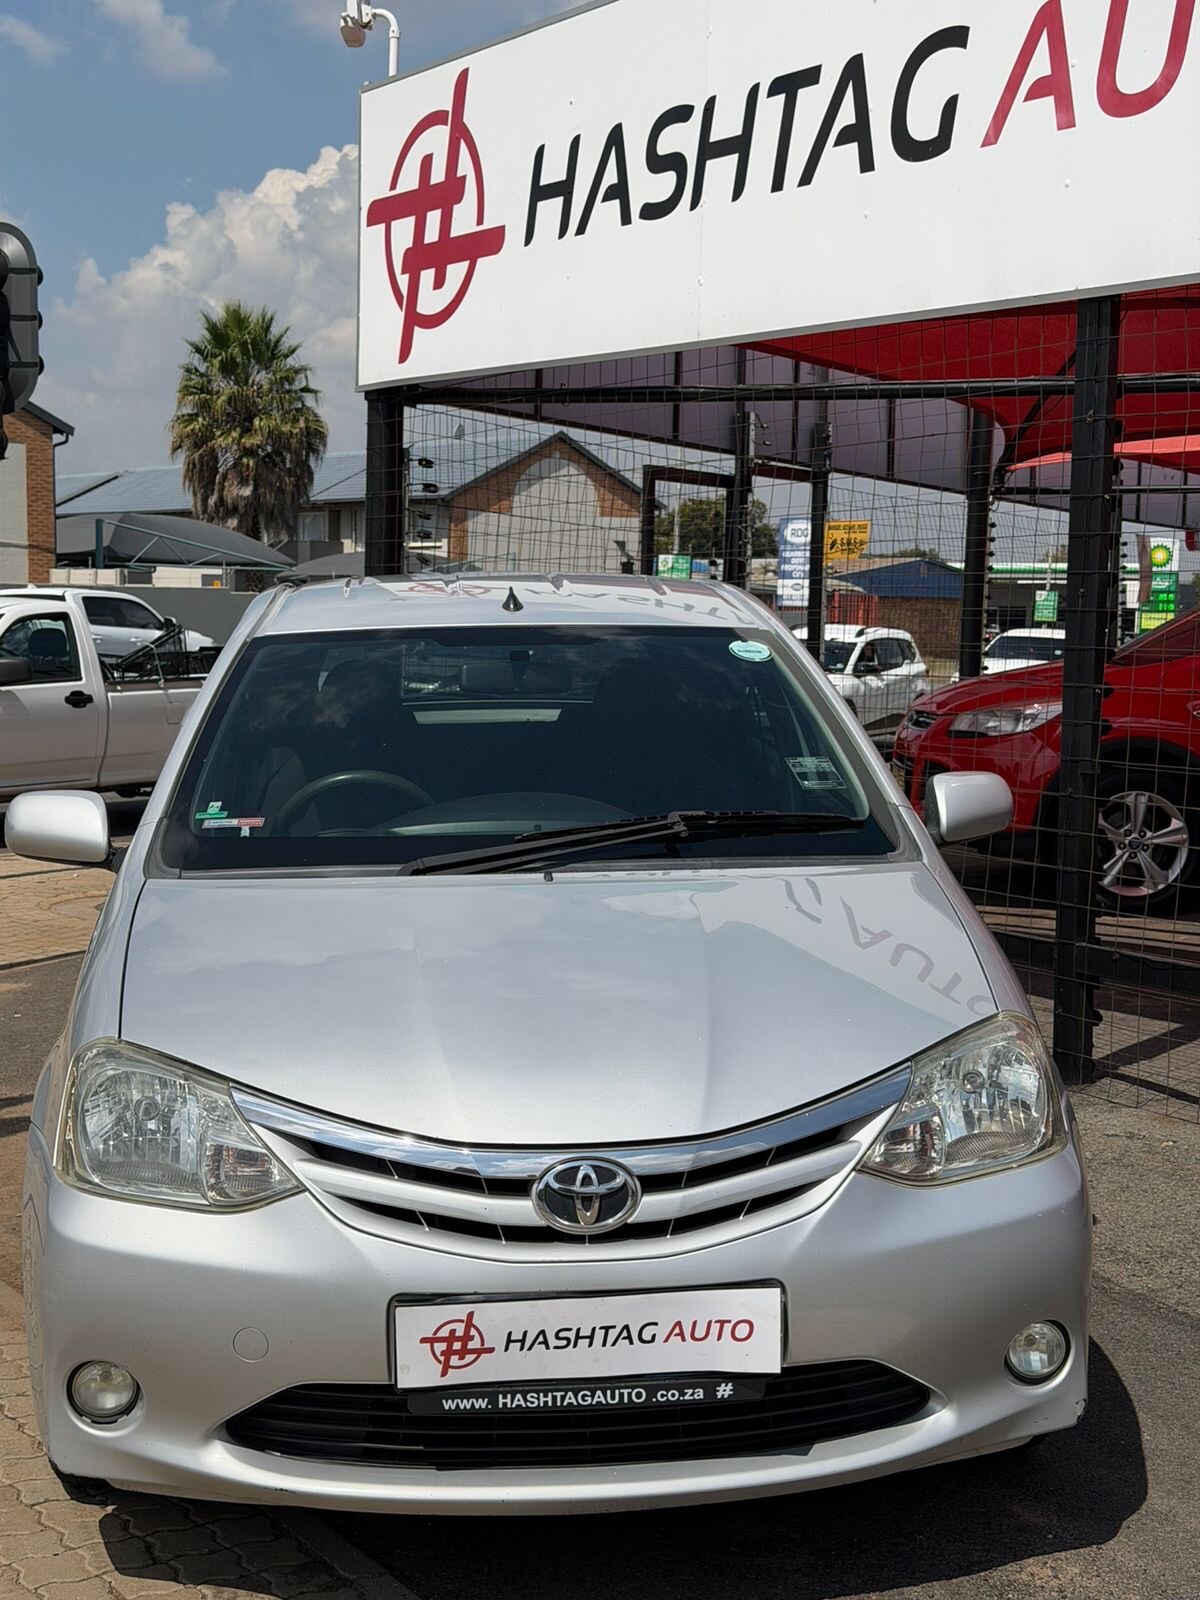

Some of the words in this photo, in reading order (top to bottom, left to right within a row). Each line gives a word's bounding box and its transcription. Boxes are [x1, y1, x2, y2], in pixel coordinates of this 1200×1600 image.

[525, 25, 970, 247] HASHTAG
[503, 1321, 659, 1353] HASHTAG
[663, 1318, 755, 1344] AUTO
[442, 1397, 492, 1410] www.
[498, 1388, 646, 1408] HASHTAGAUTO
[652, 1387, 704, 1402] .co.za
